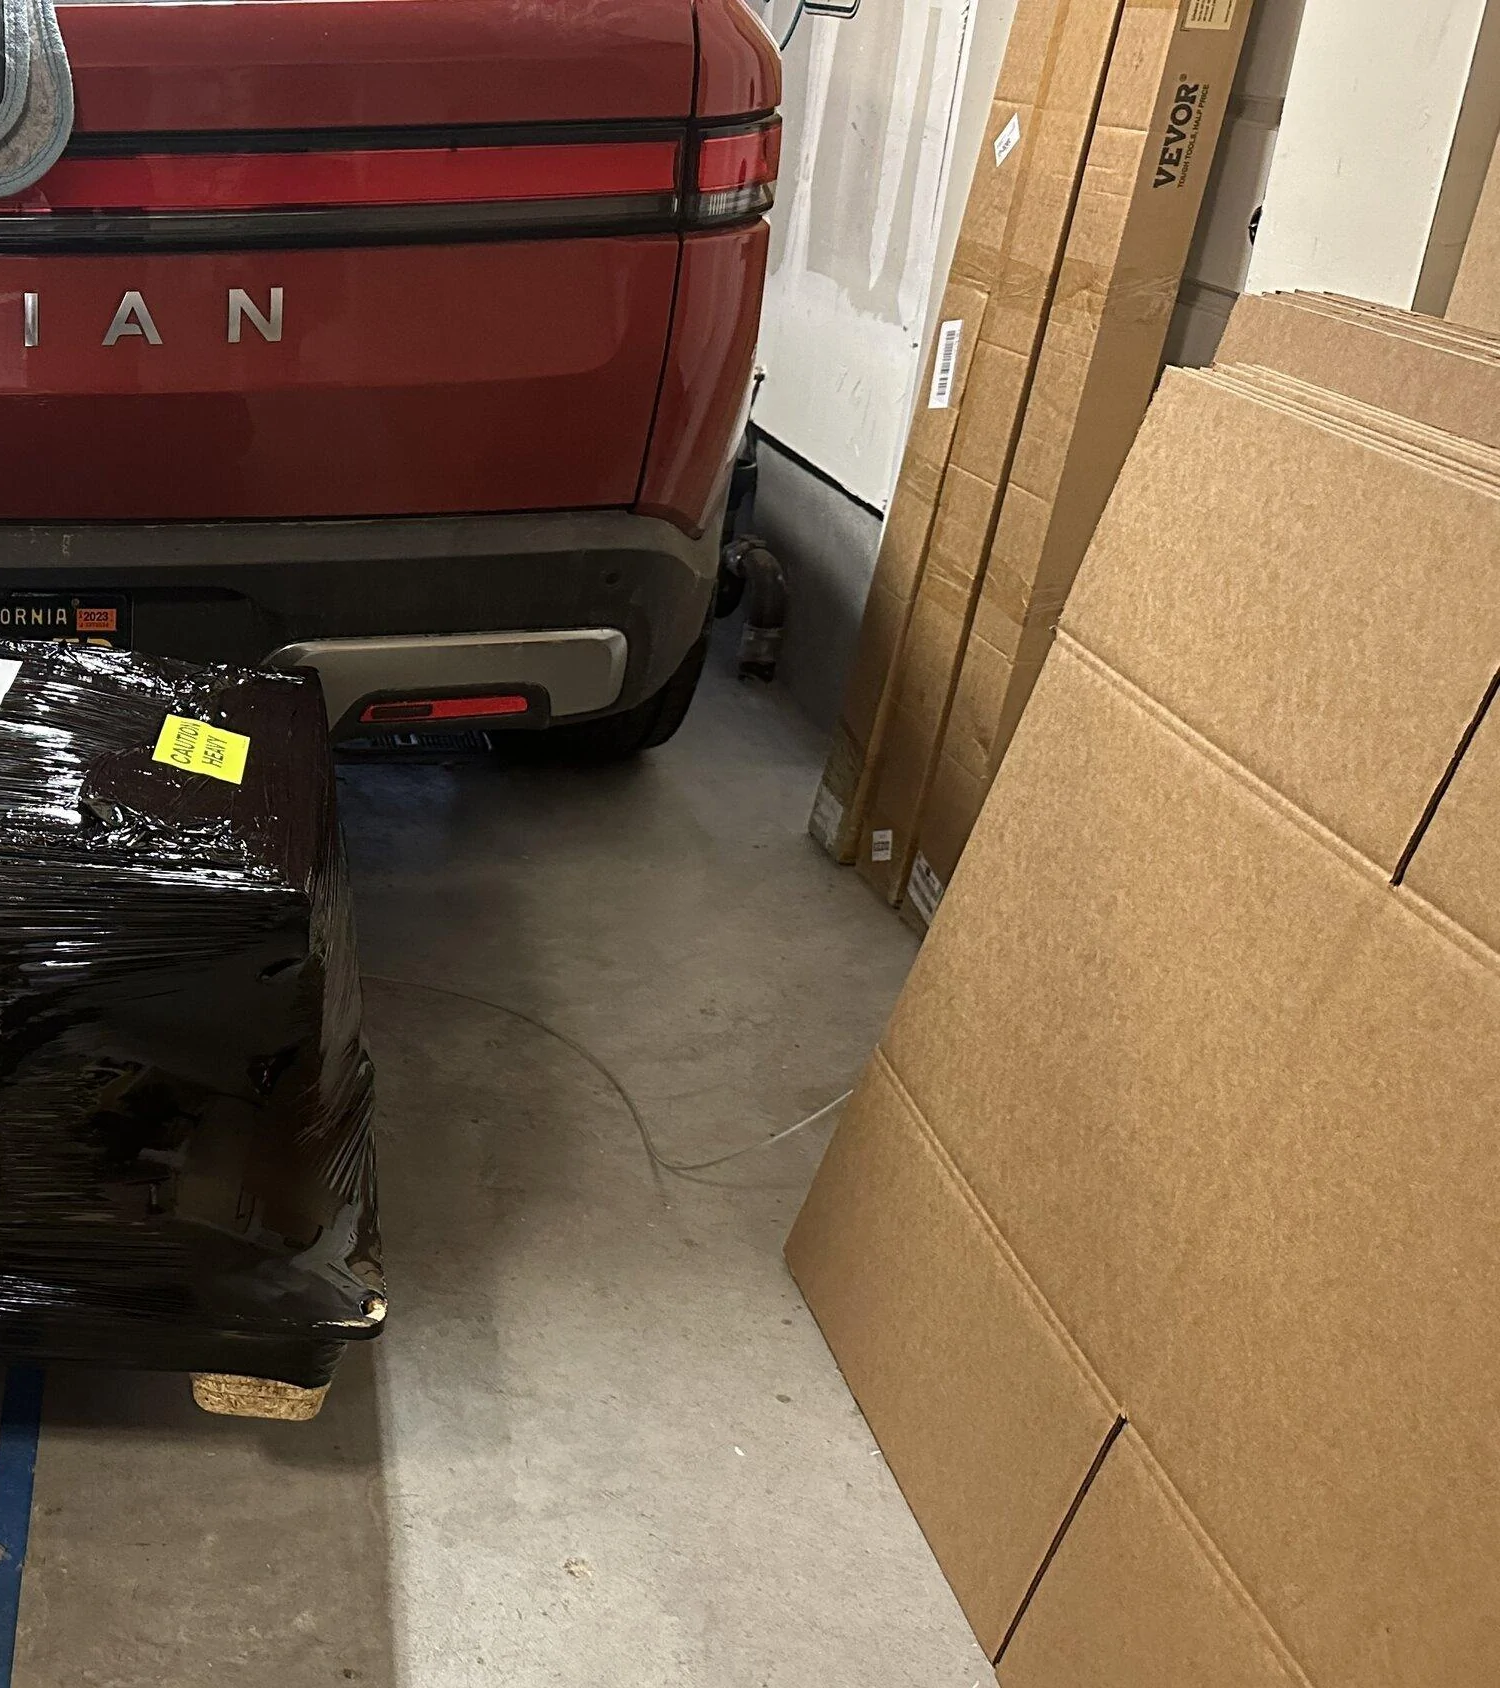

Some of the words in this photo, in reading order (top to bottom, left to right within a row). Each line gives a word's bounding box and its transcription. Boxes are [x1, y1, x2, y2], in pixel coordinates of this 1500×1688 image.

[1153, 84, 1199, 188] VEVOR
[1177, 161, 1190, 188] TOUGH
[1198, 83, 1210, 108] PRICE
[83, 611, 109, 622] 2023
[170, 720, 202, 765] CAUTION
[201, 734, 228, 769] HEAVY
